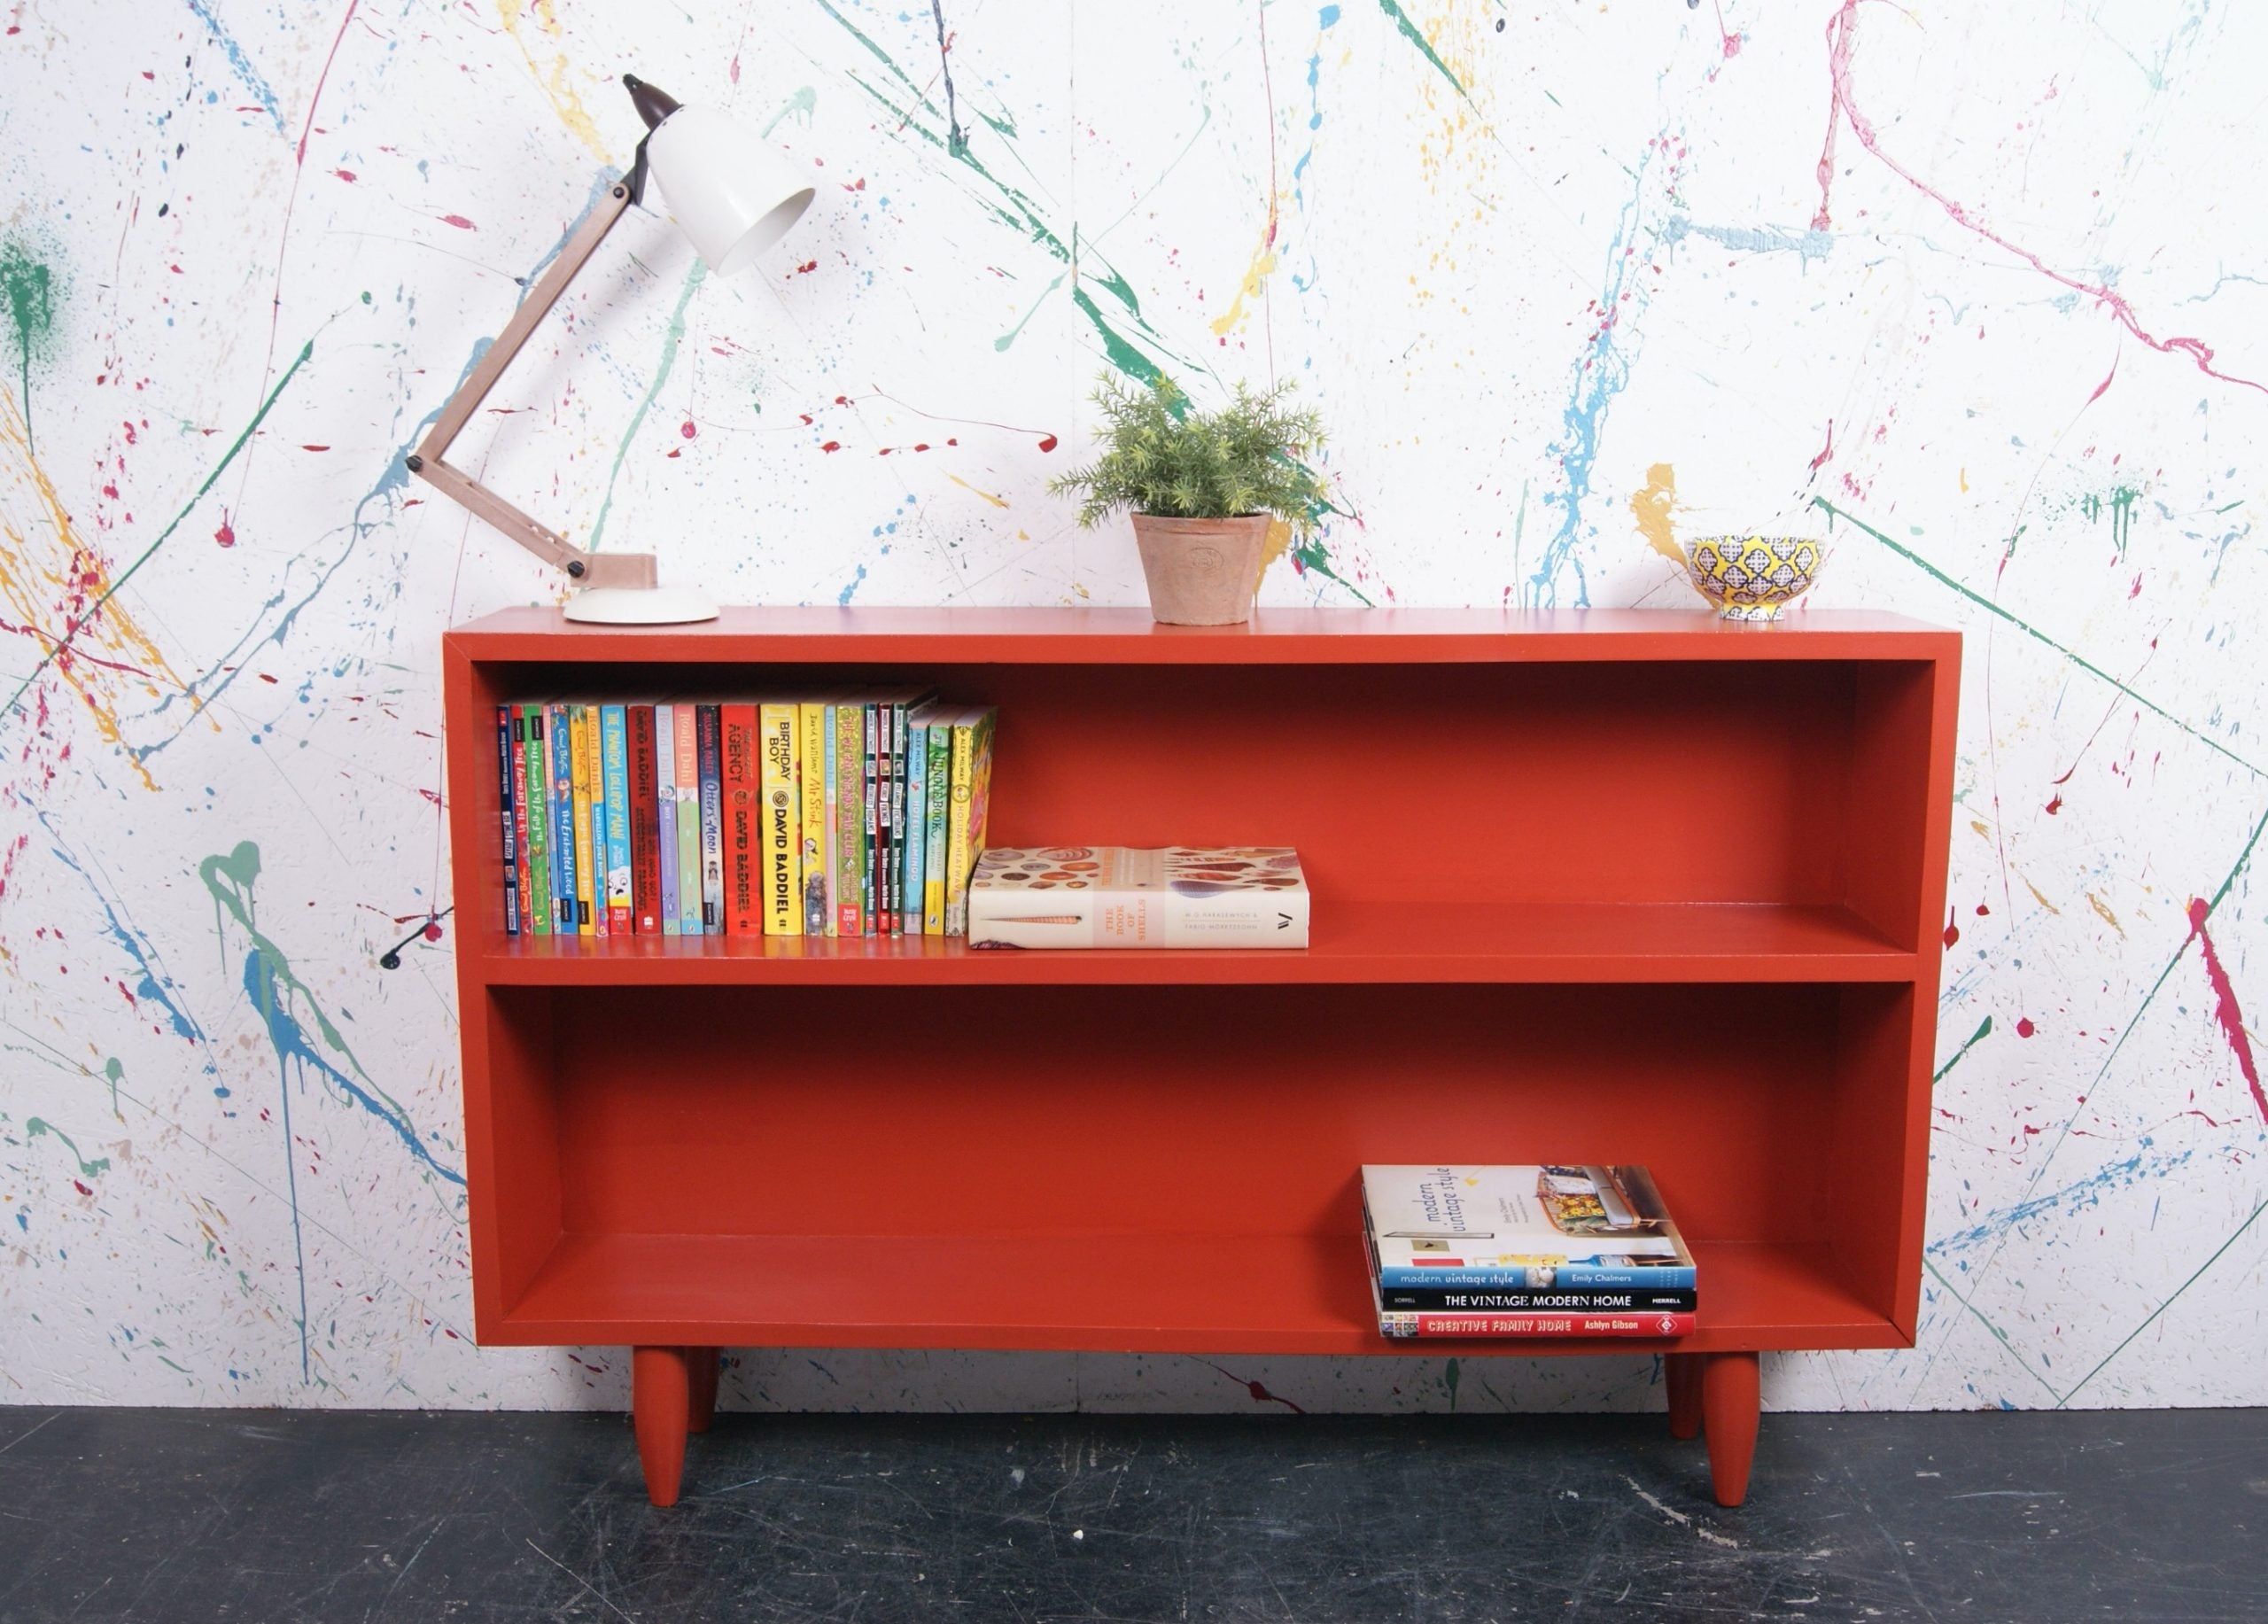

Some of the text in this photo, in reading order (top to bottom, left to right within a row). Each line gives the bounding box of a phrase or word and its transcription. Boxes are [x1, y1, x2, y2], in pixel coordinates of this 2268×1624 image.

[515, 748, 524, 764] Tree
[589, 715, 601, 794] Roald Dahl's
[607, 729, 622, 769] PHANTOM
[658, 713, 671, 782] Roald Dahl
[680, 714, 693, 782] Roald Dahl
[703, 712, 713, 776] SUSANNA BAILEY
[728, 724, 743, 782] AGENCY
[769, 737, 779, 765] BOY
[780, 722, 790, 781] BIRTHDAY
[516, 768, 525, 805] Faraway
[532, 762, 541, 792] Faraway
[637, 748, 649, 797] BADDIEL
[809, 779, 821, 795] Mr
[933, 753, 944, 798] JUNGLE
[610, 773, 623, 812] LOLLIPOP
[809, 798, 822, 828] Stink
[931, 800, 943, 838] BOOK
[562, 826, 573, 869] Enchanted
[705, 820, 718, 853] Moon
[843, 834, 856, 858] CLUB
[736, 811, 750, 913] DAVID BADDIEL
[775, 809, 788, 913] DAVID BADDIEL
[911, 833, 920, 882] FLAMINGO
[953, 847, 962, 893] HEATWAVE
[565, 872, 574, 894] Wood
[1127, 913, 1134, 928] OF
[1412, 1183, 1441, 1222] modern
[1426, 1168, 1466, 1232] vintage style
[1401, 1270, 1513, 1286] modern vintage style
[1572, 1273, 1632, 1284] Emily Chalmers
[1445, 1295, 1632, 1307] THE VINTAGE MODERN HOME
[1427, 1319, 1572, 1333] CREATIVE FAMILY HOME
[1584, 1320, 1639, 1331] Ashlyn Gibson
